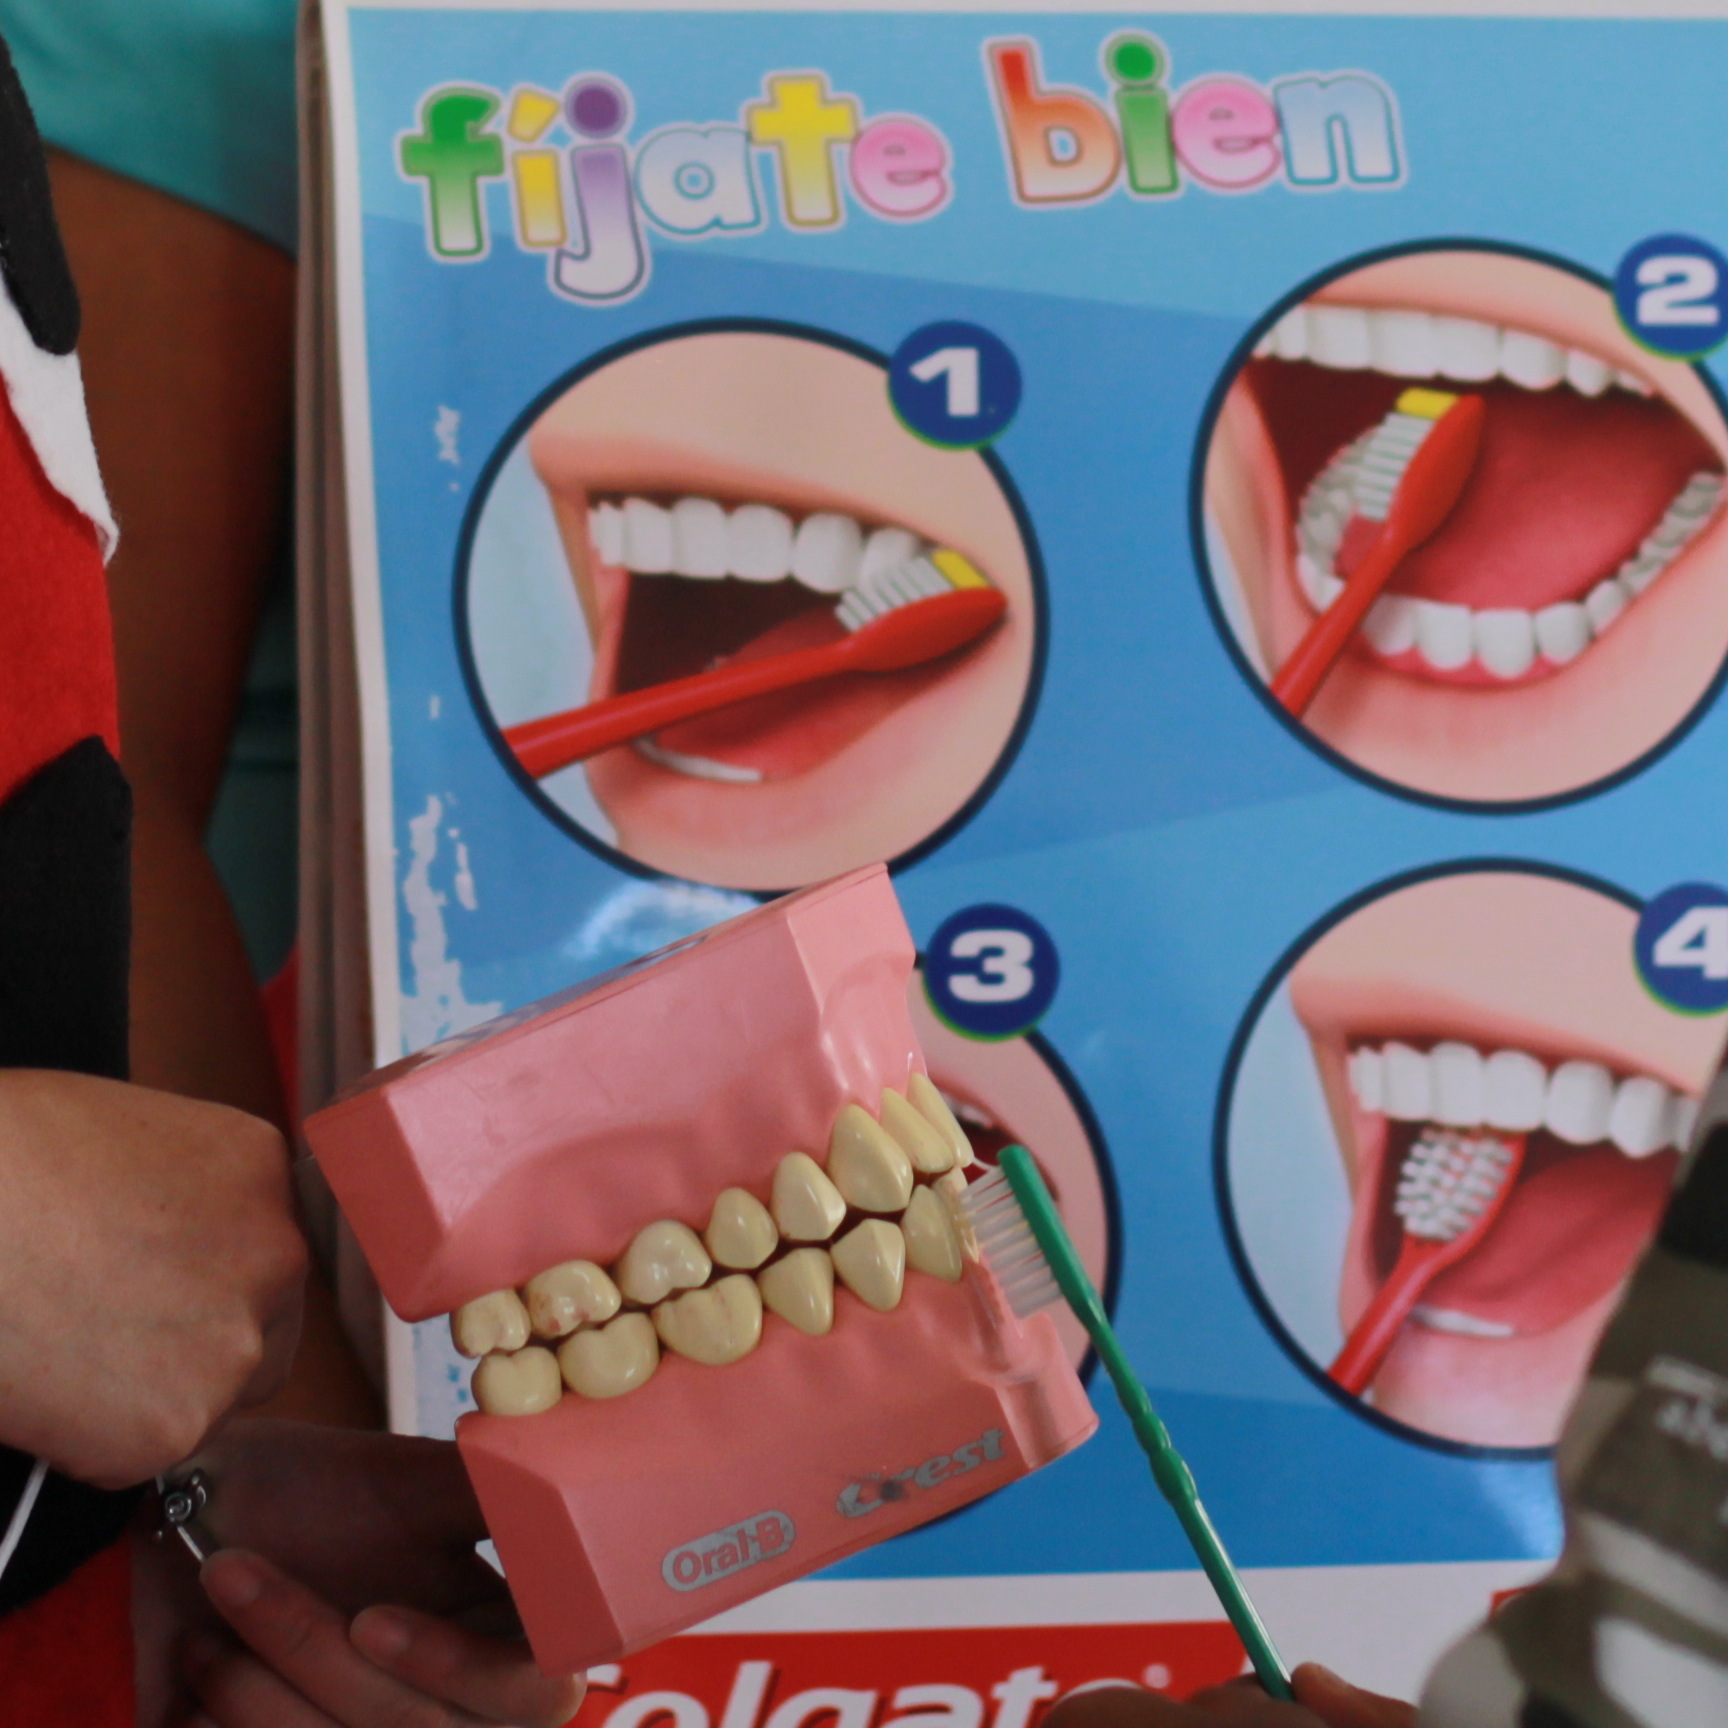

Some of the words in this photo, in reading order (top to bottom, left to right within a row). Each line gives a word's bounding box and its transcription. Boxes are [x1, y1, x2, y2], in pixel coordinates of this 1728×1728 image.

[394, 69, 954, 305] fíjate
[982, 29, 1407, 210] bien
[1635, 255, 1719, 326] 2
[909, 346, 980, 417] 1
[948, 929, 1034, 1003] 3
[672, 1516, 785, 1585] Oral-B
[587, 1660, 1144, 1728] olat
